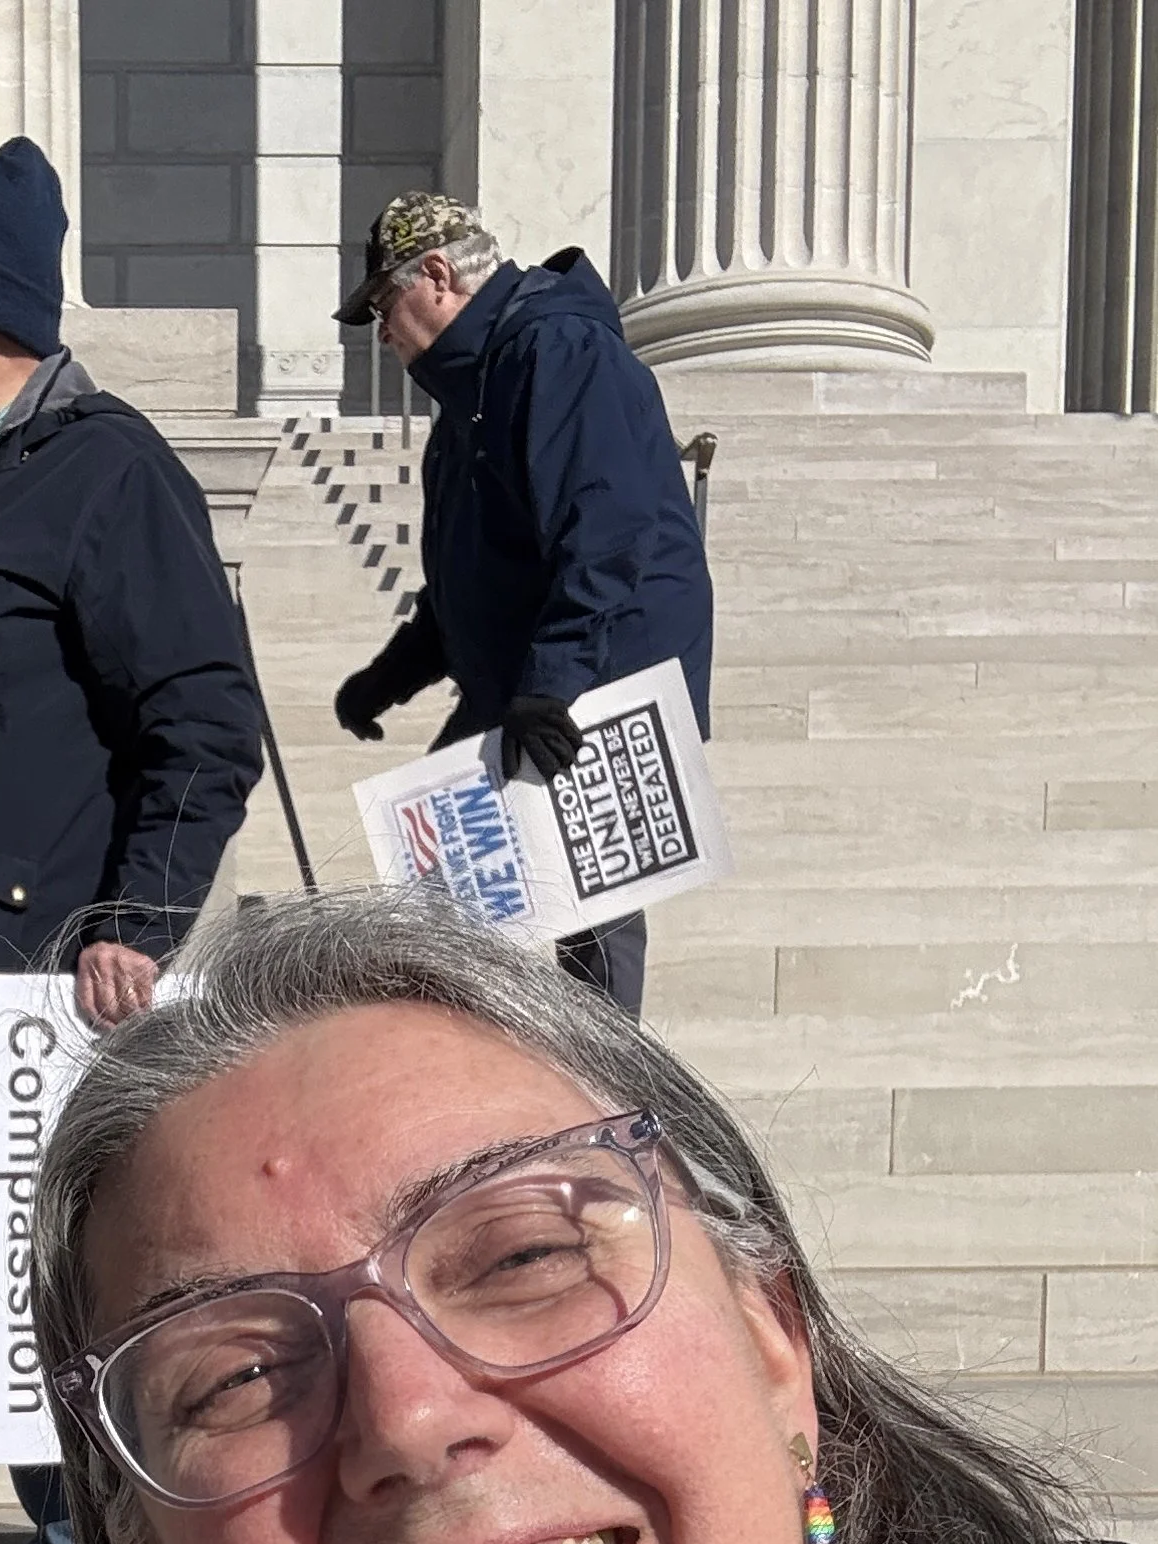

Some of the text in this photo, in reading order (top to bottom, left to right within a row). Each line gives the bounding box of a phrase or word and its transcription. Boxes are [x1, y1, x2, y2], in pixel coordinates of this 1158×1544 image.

[552, 773, 602, 894] THE PEOP
[575, 741, 632, 879] UNITED
[602, 724, 656, 871] WILL NEVER BE
[628, 719, 683, 858] DEFEATED
[475, 861, 525, 921] WE
